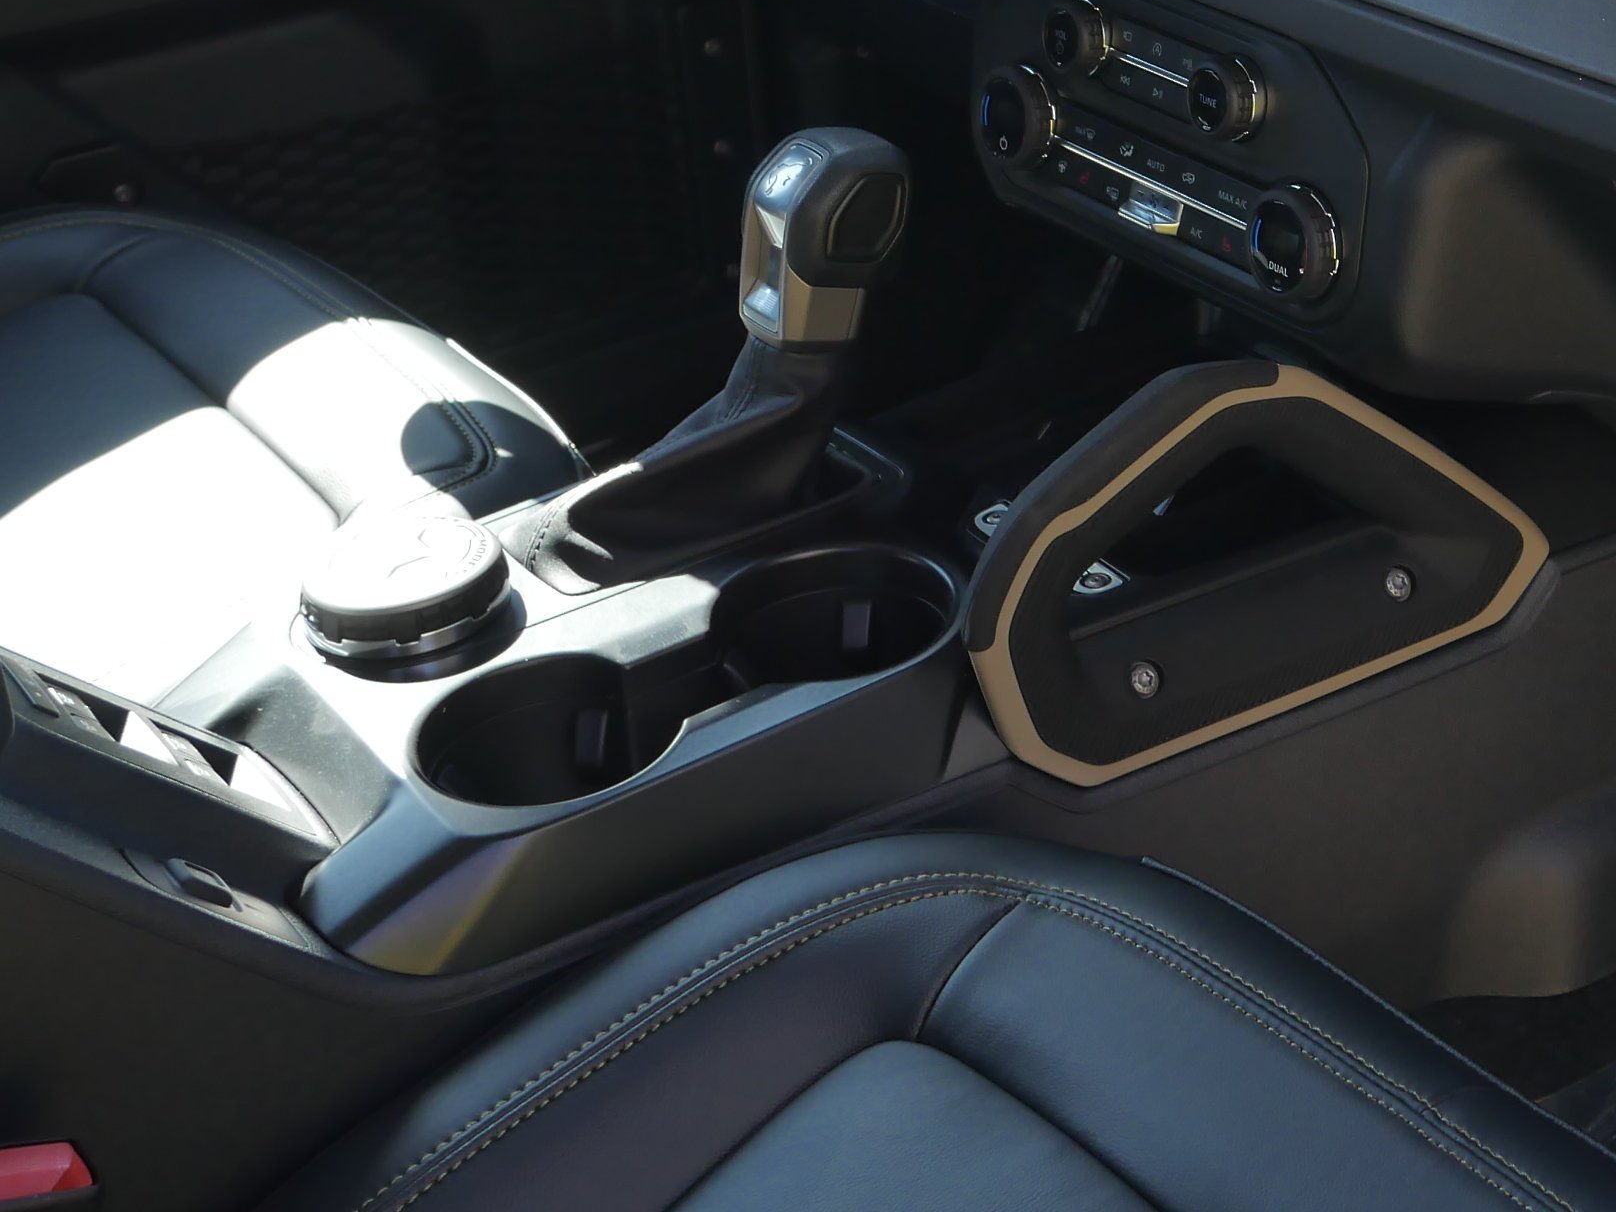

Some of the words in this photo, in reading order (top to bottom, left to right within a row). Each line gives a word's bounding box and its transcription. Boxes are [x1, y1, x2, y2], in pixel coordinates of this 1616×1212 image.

[1055, 29, 1067, 41] VOL
[1199, 93, 1217, 109] TUNE
[1147, 158, 1165, 172] AUTO
[1218, 190, 1234, 204] MAX
[1234, 197, 1247, 210] A/C
[1190, 227, 1203, 239] A/C
[1267, 260, 1289, 279] DUAL
